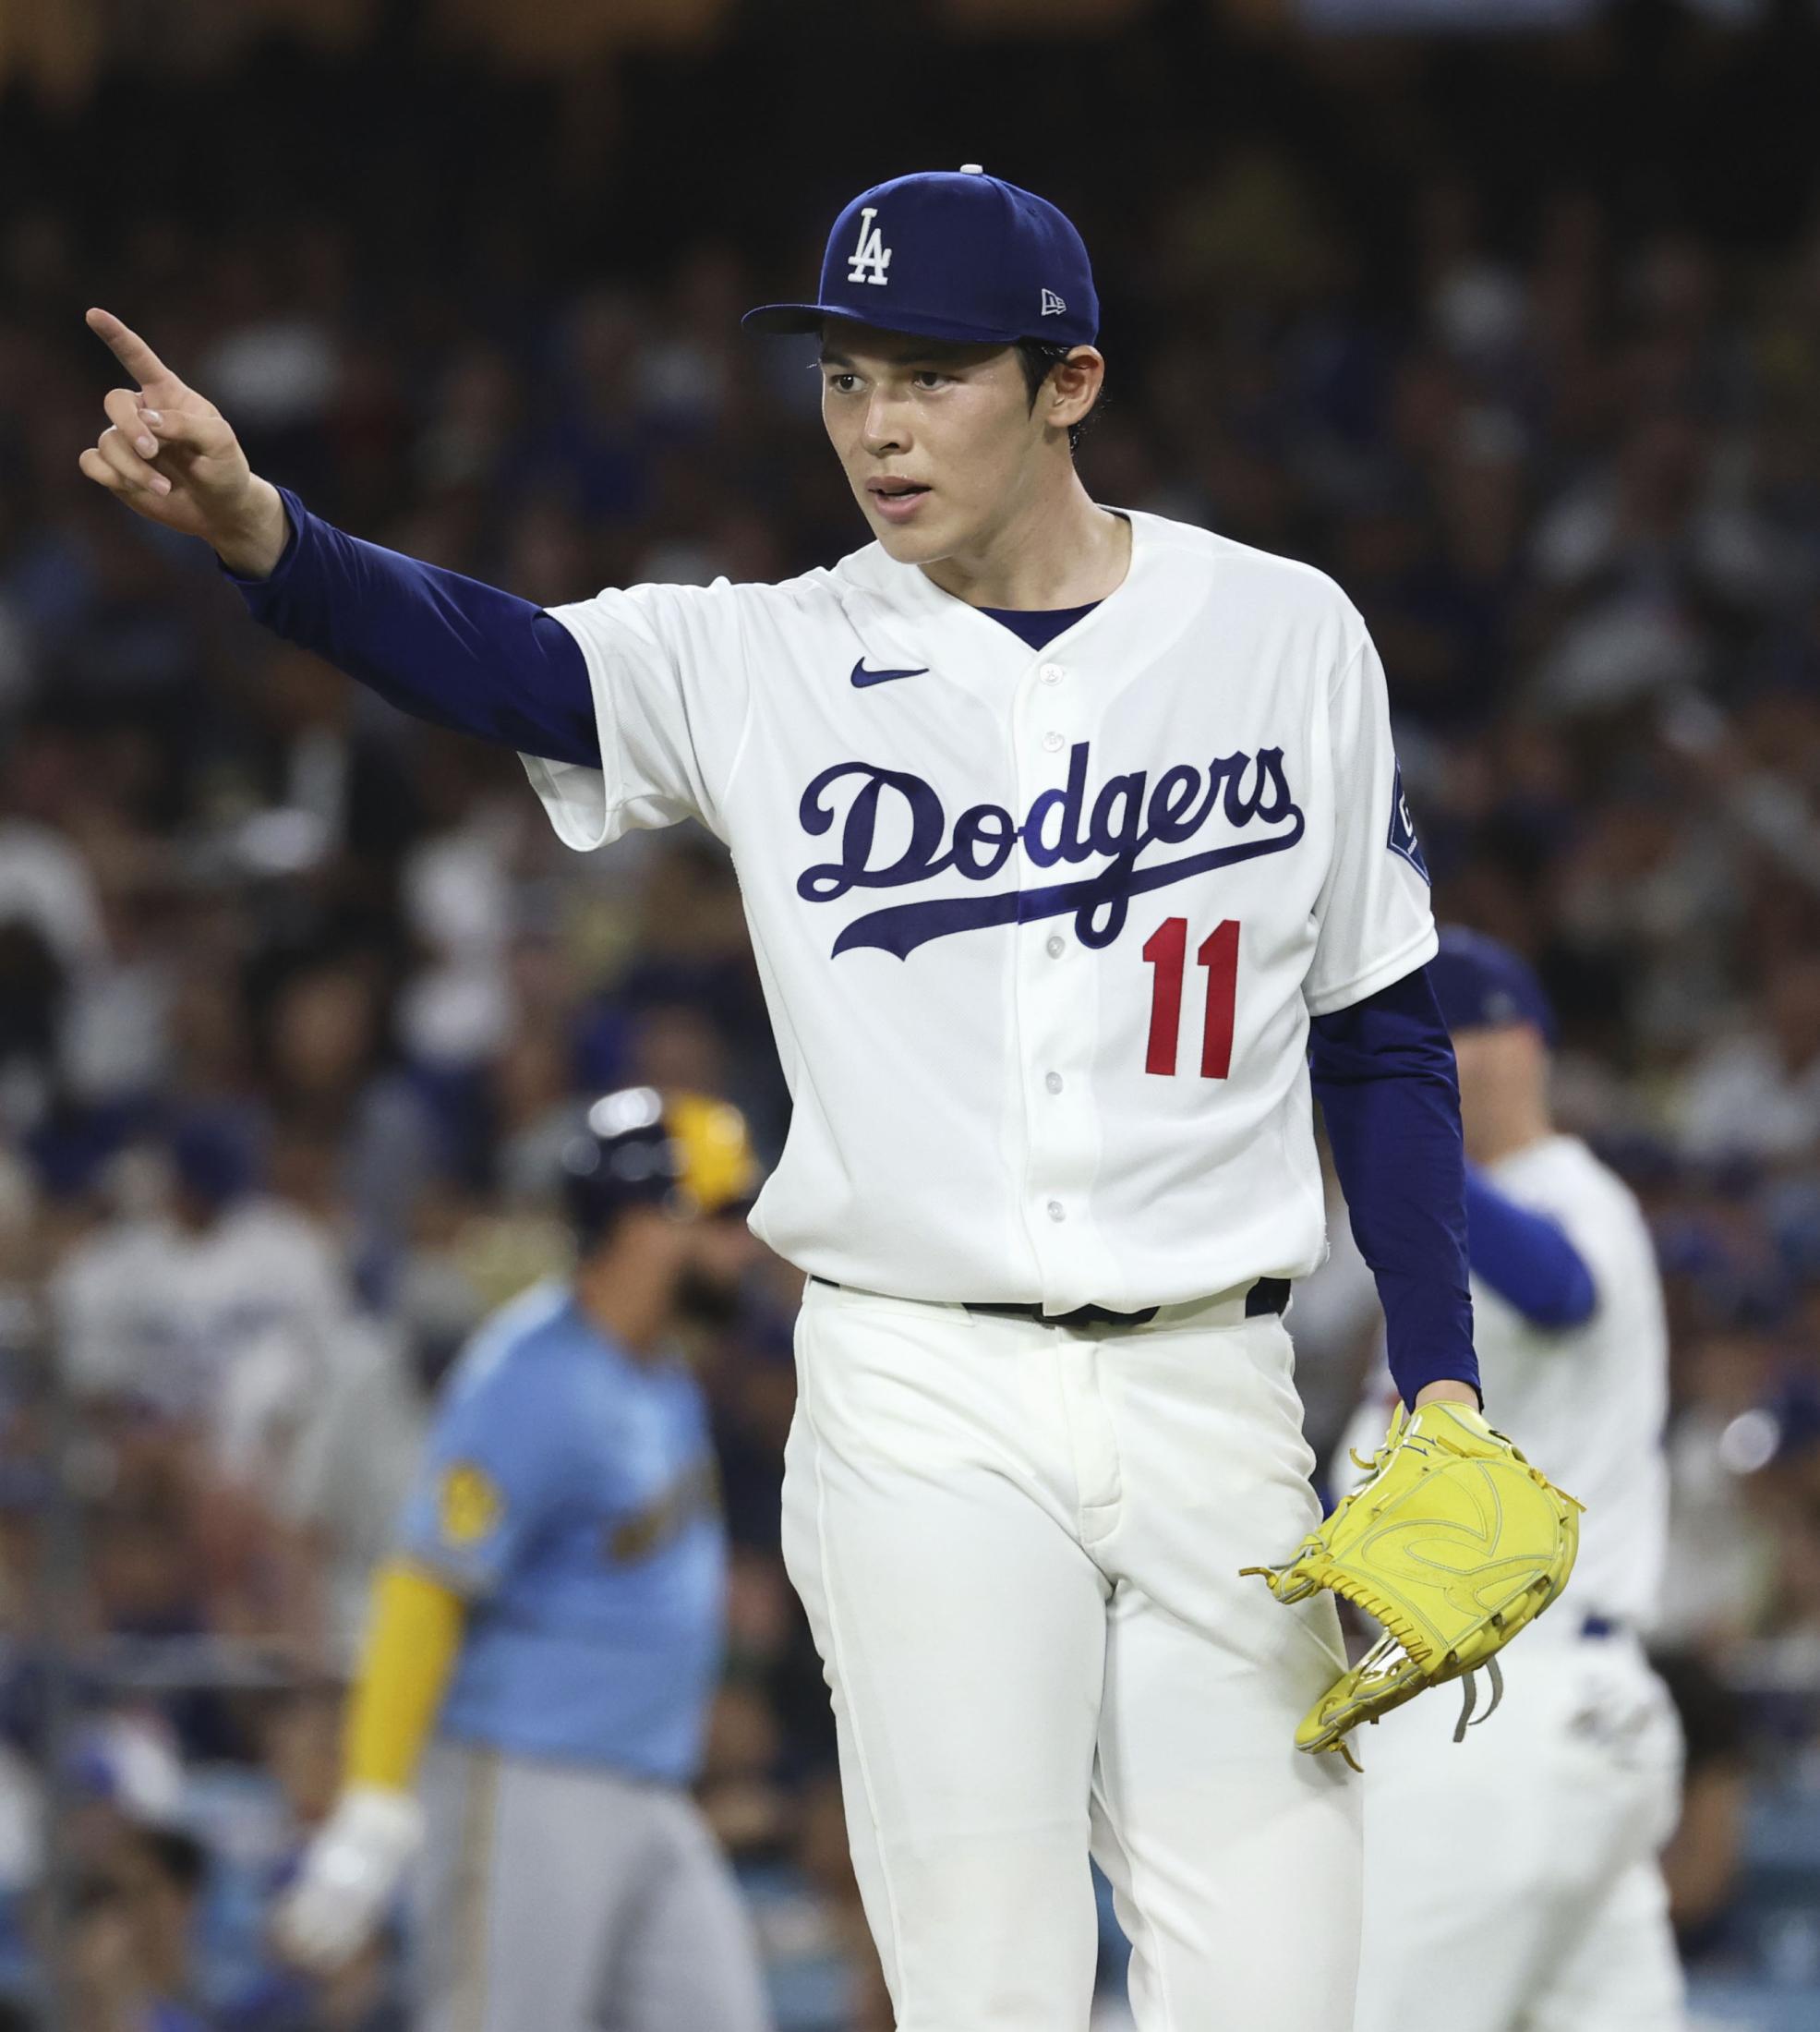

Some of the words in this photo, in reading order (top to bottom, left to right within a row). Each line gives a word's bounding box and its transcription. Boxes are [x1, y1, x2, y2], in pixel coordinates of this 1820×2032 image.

[847, 207, 892, 285] LA
[797, 742, 1305, 949] Dodgers
[1142, 917, 1241, 1080] 11
